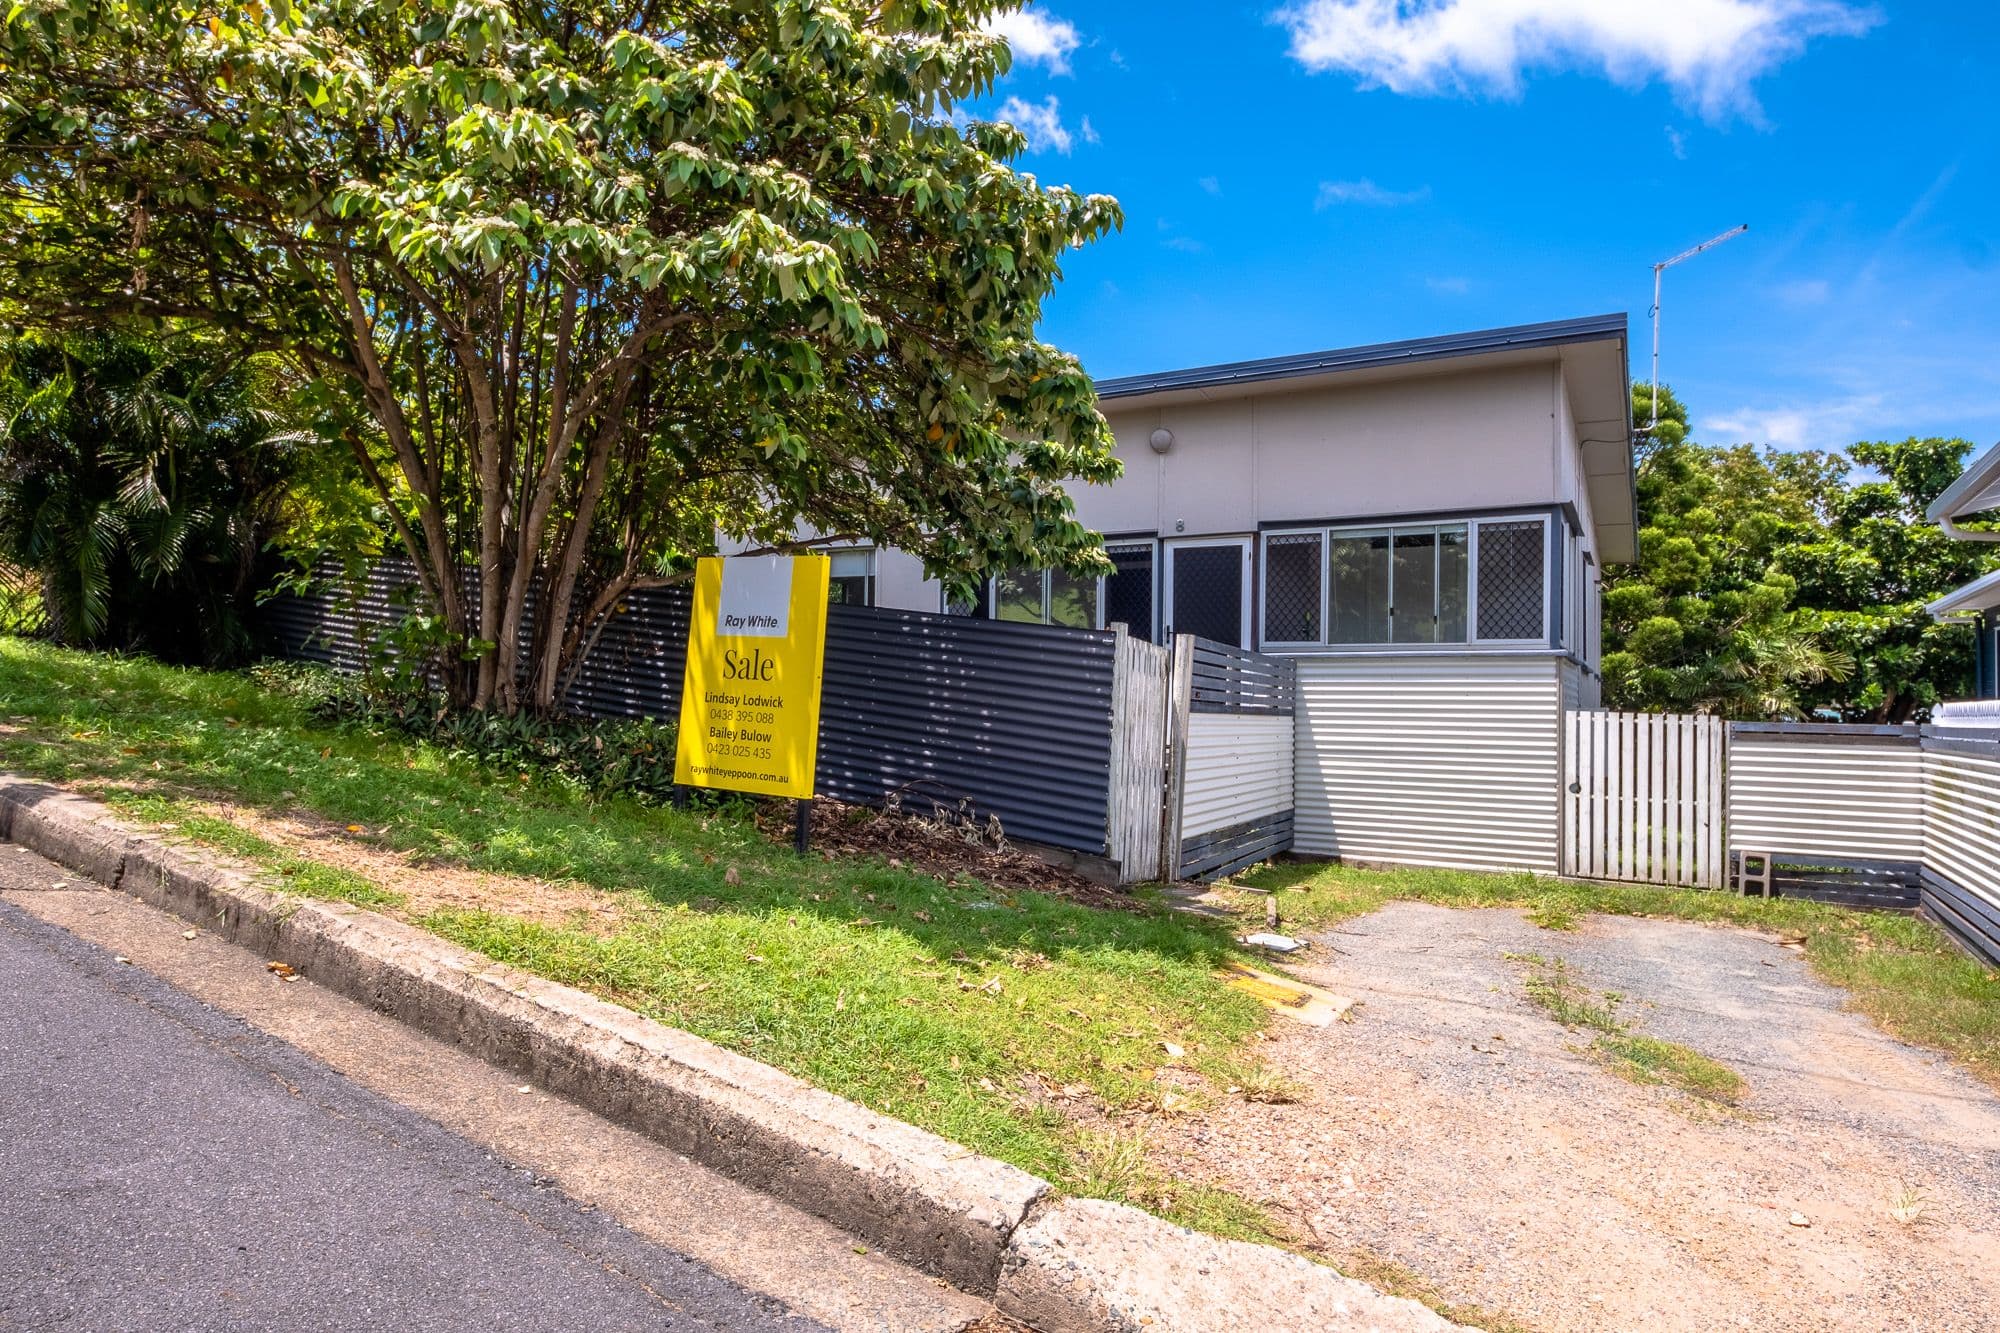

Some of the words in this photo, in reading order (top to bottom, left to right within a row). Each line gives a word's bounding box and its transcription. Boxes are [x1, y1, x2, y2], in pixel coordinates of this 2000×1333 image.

[725, 615, 745, 629] Ray
[748, 616, 778, 628] White
[723, 649, 773, 681] Sale
[705, 692, 740, 707] Lindsay
[743, 694, 784, 709] Lodwick
[710, 709, 733, 721] 0438
[736, 710, 753, 722] 395
[756, 712, 774, 724] 088
[710, 726, 737, 742] Bailey
[741, 729, 772, 743] Bulow
[707, 743, 730, 755] 0423
[733, 745, 750, 757] 025
[753, 747, 771, 759] 435
[690, 765, 789, 784] raywhiteyeppoon.com.au
